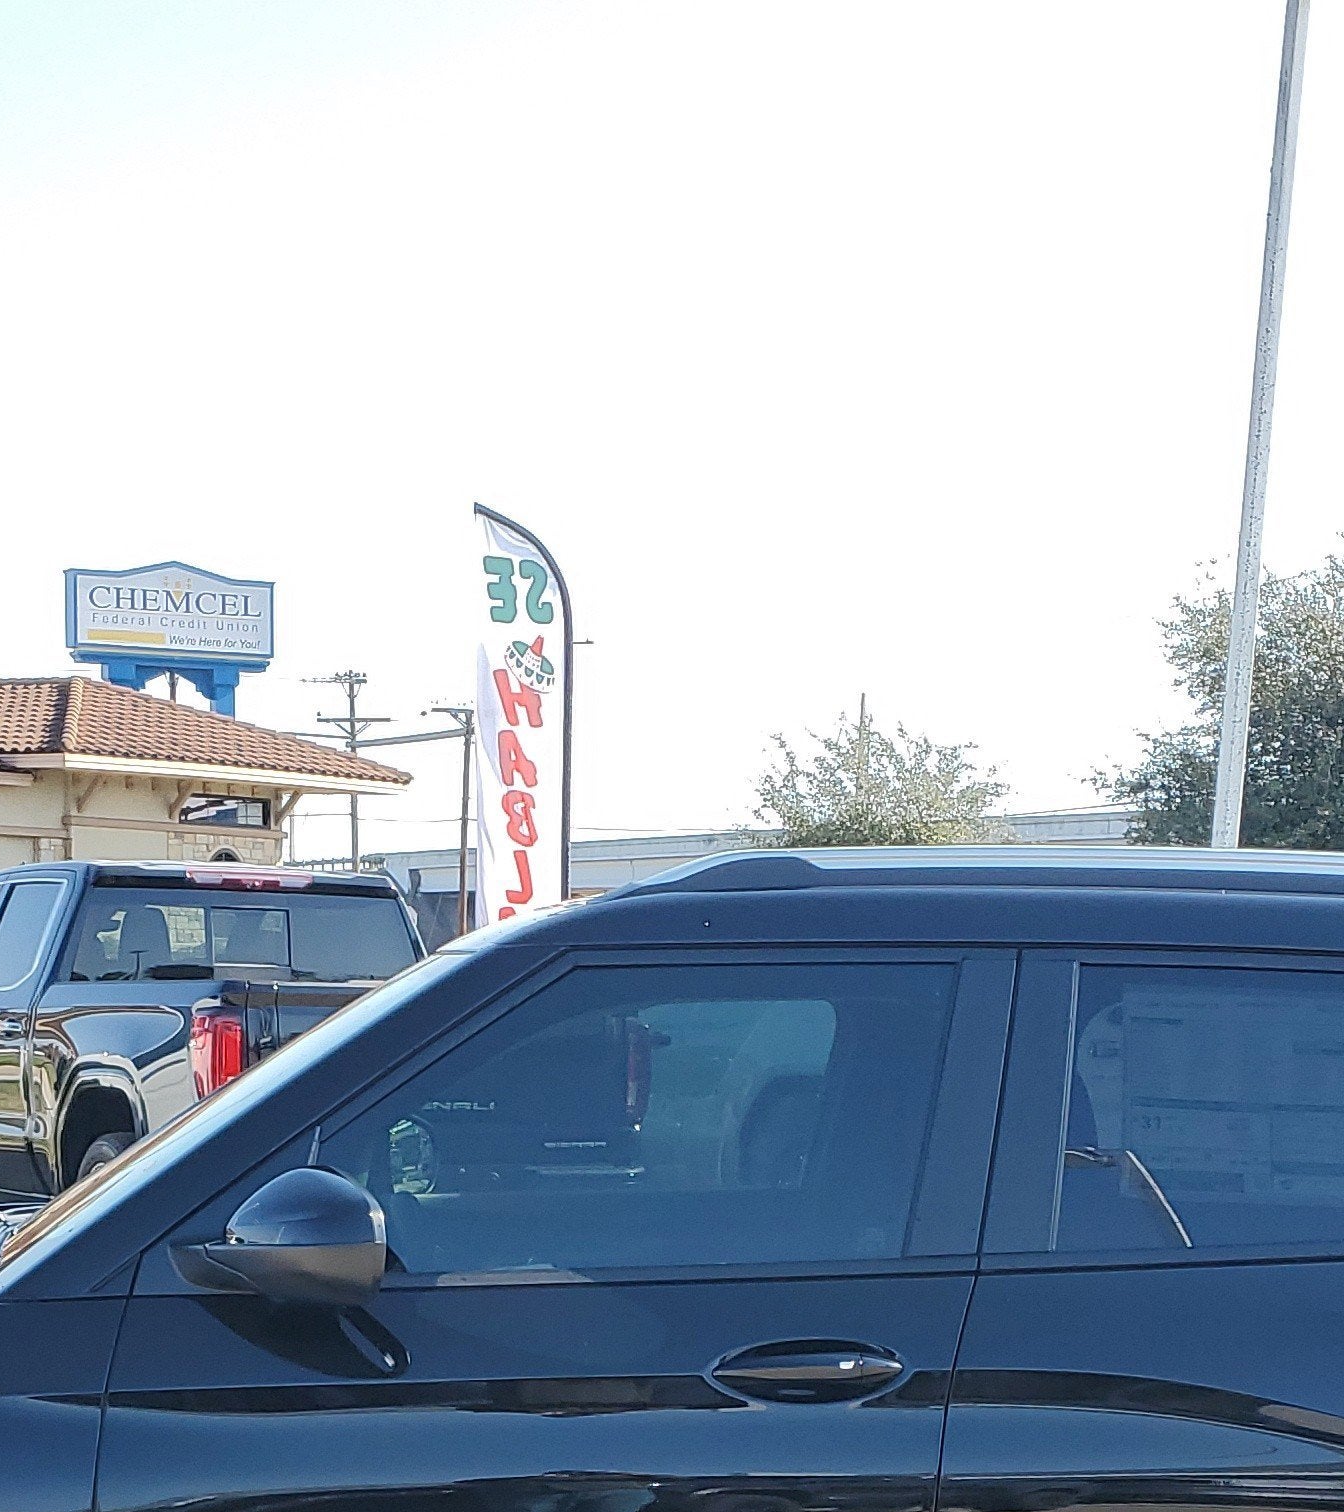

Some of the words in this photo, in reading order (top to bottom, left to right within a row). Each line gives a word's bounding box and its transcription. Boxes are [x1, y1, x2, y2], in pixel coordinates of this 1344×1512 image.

[88, 585, 262, 618] CHEMCEL
[92, 613, 151, 627] Federal
[160, 616, 207, 631] Credit
[216, 620, 259, 633] Union
[169, 635, 196, 647] We're
[199, 637, 222, 648] Here
[224, 638, 237, 648] for
